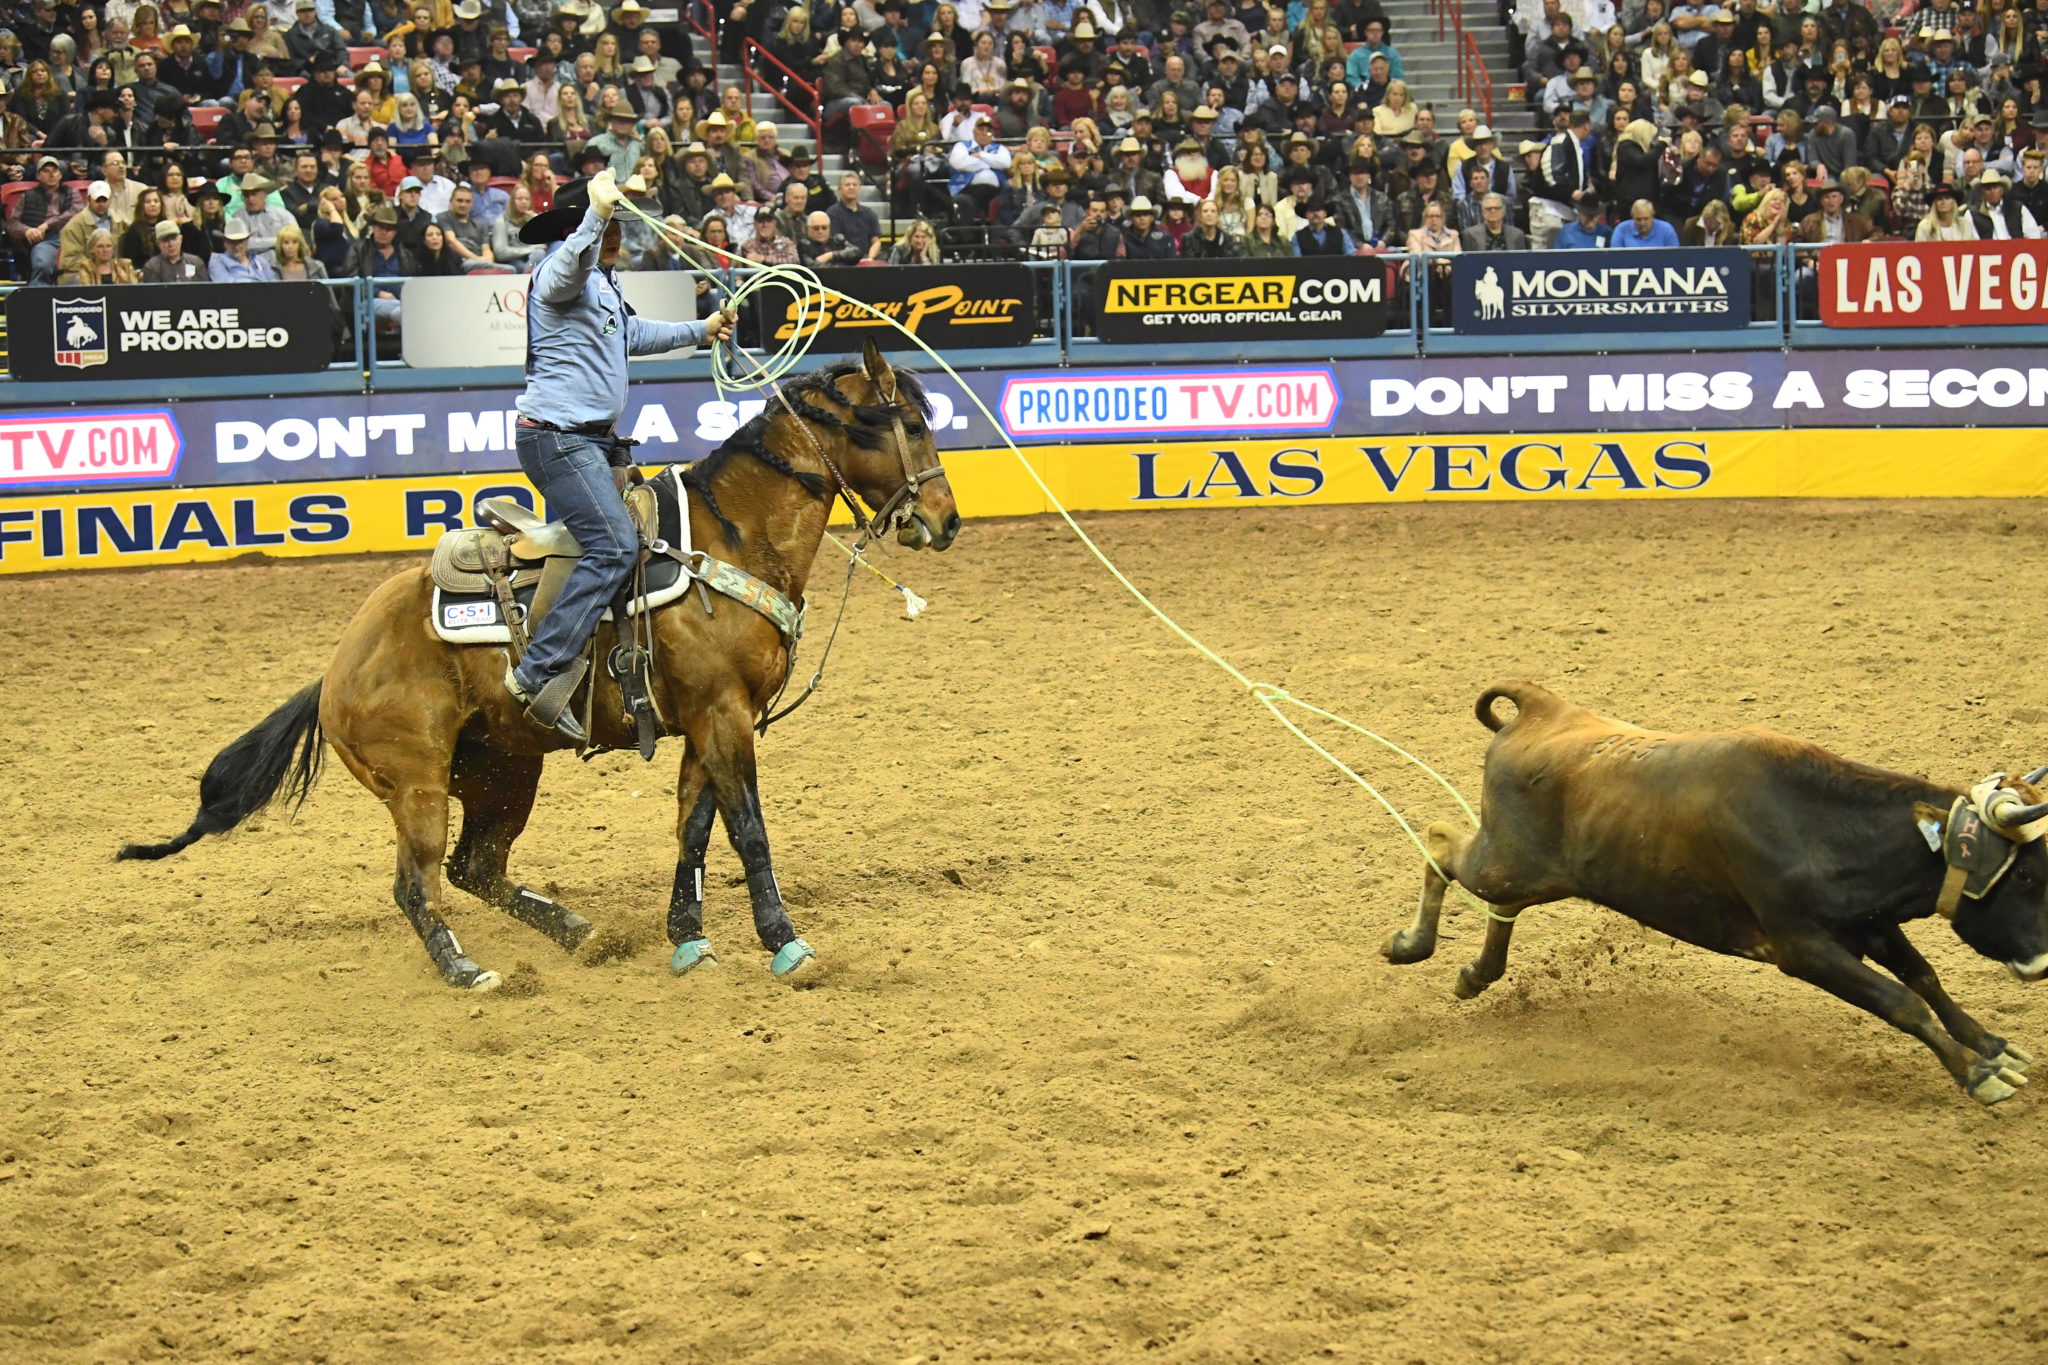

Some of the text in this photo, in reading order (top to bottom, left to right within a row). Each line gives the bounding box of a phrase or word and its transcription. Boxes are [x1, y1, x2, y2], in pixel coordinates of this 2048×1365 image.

[1116, 277, 1381, 307] NFRGEAR.COM
[1511, 266, 1727, 299] MONTANA
[1836, 252, 2048, 313] LAS VEG
[120, 308, 239, 331] WE ARE
[485, 292, 527, 318] AQ
[904, 285, 1023, 335] POINT
[1143, 310, 1342, 326] GET YOUR OFFICIAL GEAR
[1511, 300, 1730, 317] SILVERSMITHS
[120, 327, 289, 352] PRORODEO
[1019, 382, 1319, 425] PRORODEO TV.COM
[1370, 376, 1568, 417] DON'T
[1588, 372, 1754, 413] MISS
[1773, 370, 1825, 409] A
[0, 425, 159, 471] TV.COM
[215, 413, 426, 464] DON'T
[448, 409, 520, 453] MI
[630, 403, 679, 444] A
[1130, 441, 1711, 501] LAS VEGAS
